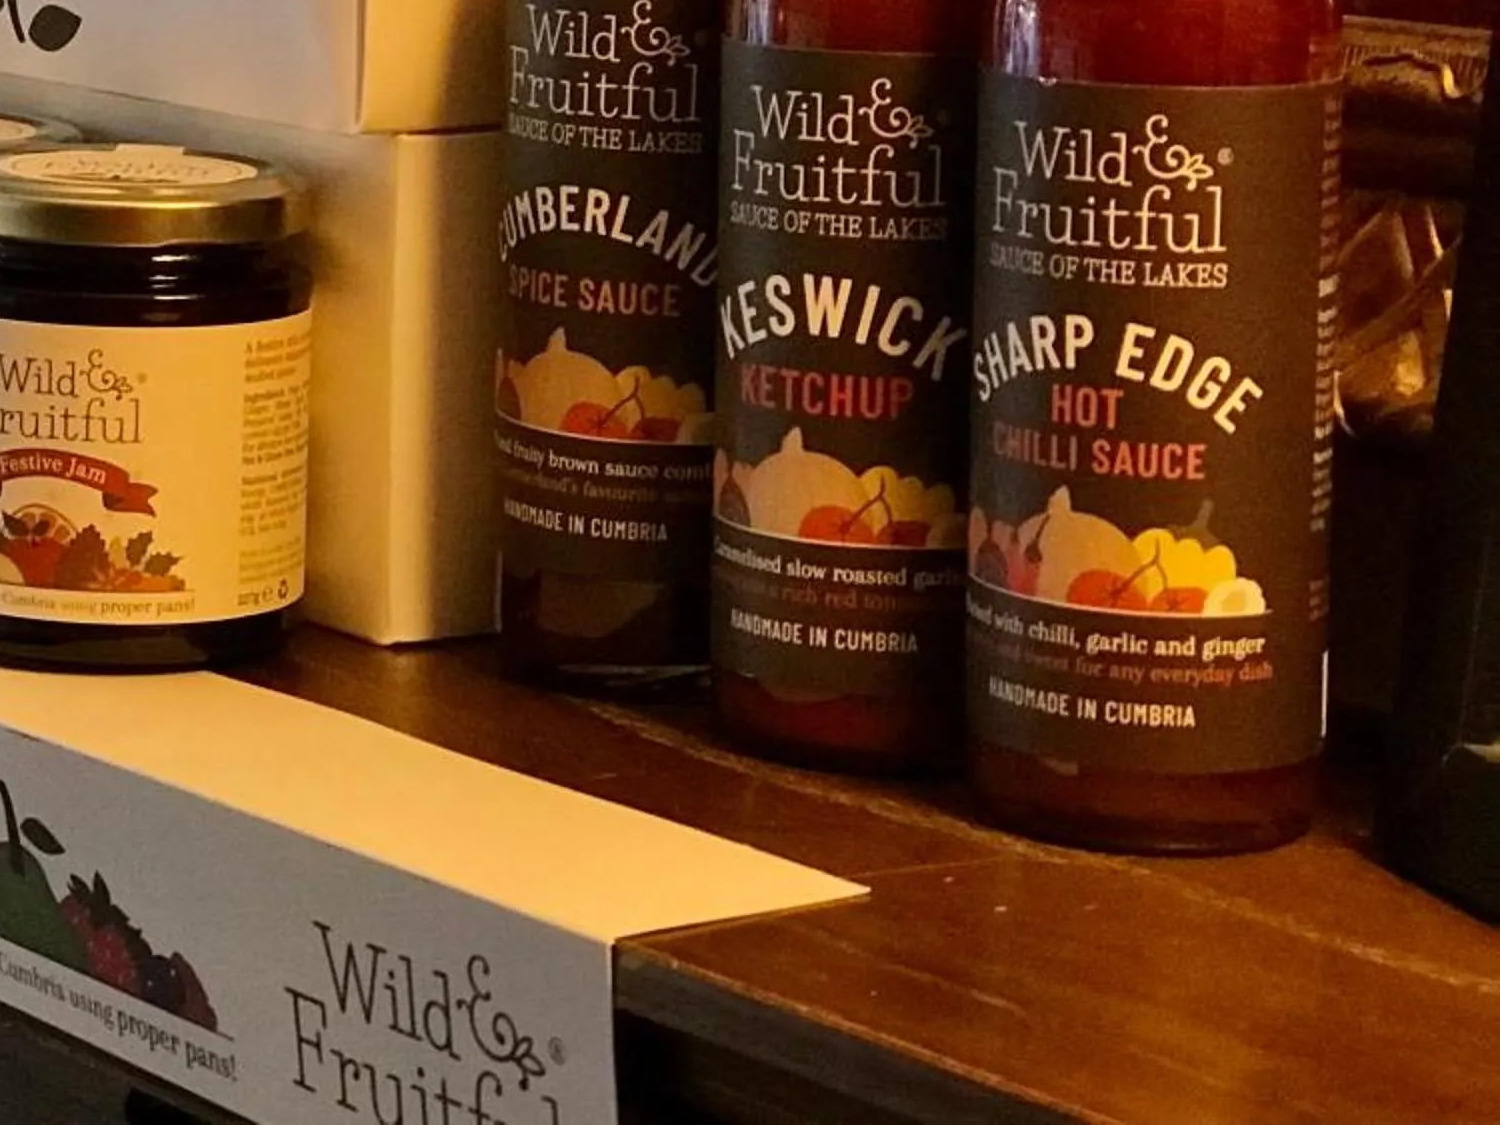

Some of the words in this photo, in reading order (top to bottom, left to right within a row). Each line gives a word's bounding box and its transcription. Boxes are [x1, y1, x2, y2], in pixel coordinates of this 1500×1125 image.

[526, 3, 620, 63] Wild
[621, 0, 690, 66] &
[509, 45, 701, 123] Fruitful
[509, 113, 548, 141] SAUCE
[552, 124, 576, 147] OF
[580, 127, 622, 150] THE
[628, 130, 702, 154] LAKES
[751, 85, 859, 146] Wild
[858, 77, 933, 149] &
[731, 129, 946, 208] Fruitful
[1014, 120, 1132, 187] Wild
[1132, 114, 1214, 191] &
[730, 201, 779, 231] SAUCE
[783, 210, 812, 234] OF
[814, 212, 862, 239] THE
[869, 217, 948, 241] LAKES
[992, 166, 1228, 254] Fruitful
[509, 265, 569, 307] SPICE
[578, 279, 681, 317] SAUCE
[990, 243, 1045, 276] SAUCE
[1049, 254, 1080, 278] OF
[1084, 258, 1135, 286] THE
[1143, 262, 1228, 288] LAKES
[720, 273, 967, 381] KESWICK
[79, 348, 134, 401] &
[741, 365, 914, 419] KETCHUP
[973, 314, 1095, 402] SHARP
[1115, 323, 1263, 435] EDGE
[1052, 383, 1124, 429] HOT
[0, 453, 64, 475] Festive
[67, 456, 106, 485] Jam
[549, 448, 599, 475] brown
[605, 462, 658, 478] sauce
[992, 421, 1079, 472] CHILLI
[1091, 438, 1209, 480] SAUCE
[504, 494, 563, 532] HANDMADE
[568, 513, 585, 535] IN
[591, 517, 668, 542] CUMBRIA
[787, 558, 826, 579] slow
[833, 567, 907, 587] roasted
[102, 600, 152, 621] proper
[156, 598, 195, 617] pans!
[731, 608, 803, 646] HANDMADE
[809, 625, 828, 649] IN
[834, 628, 918, 653] CUMBRIA
[1028, 621, 1081, 651] chilli,
[1086, 630, 1149, 656] garlic
[1153, 635, 1196, 658] and
[1201, 636, 1266, 664] ginger
[1075, 656, 1102, 677] for
[1109, 664, 1143, 684] any
[1150, 663, 1234, 688] everyday
[1239, 660, 1273, 682] dish
[989, 675, 1070, 717] HANDMADE
[1077, 696, 1097, 721] IN
[1105, 699, 1196, 728] CUMBRIA
[312, 920, 461, 1062] Wild
[456, 954, 546, 1091] &
[70, 988, 114, 1025] using
[117, 1006, 180, 1055] proper
[185, 1039, 239, 1082] pans!
[283, 985, 559, 1125] Fruitf
